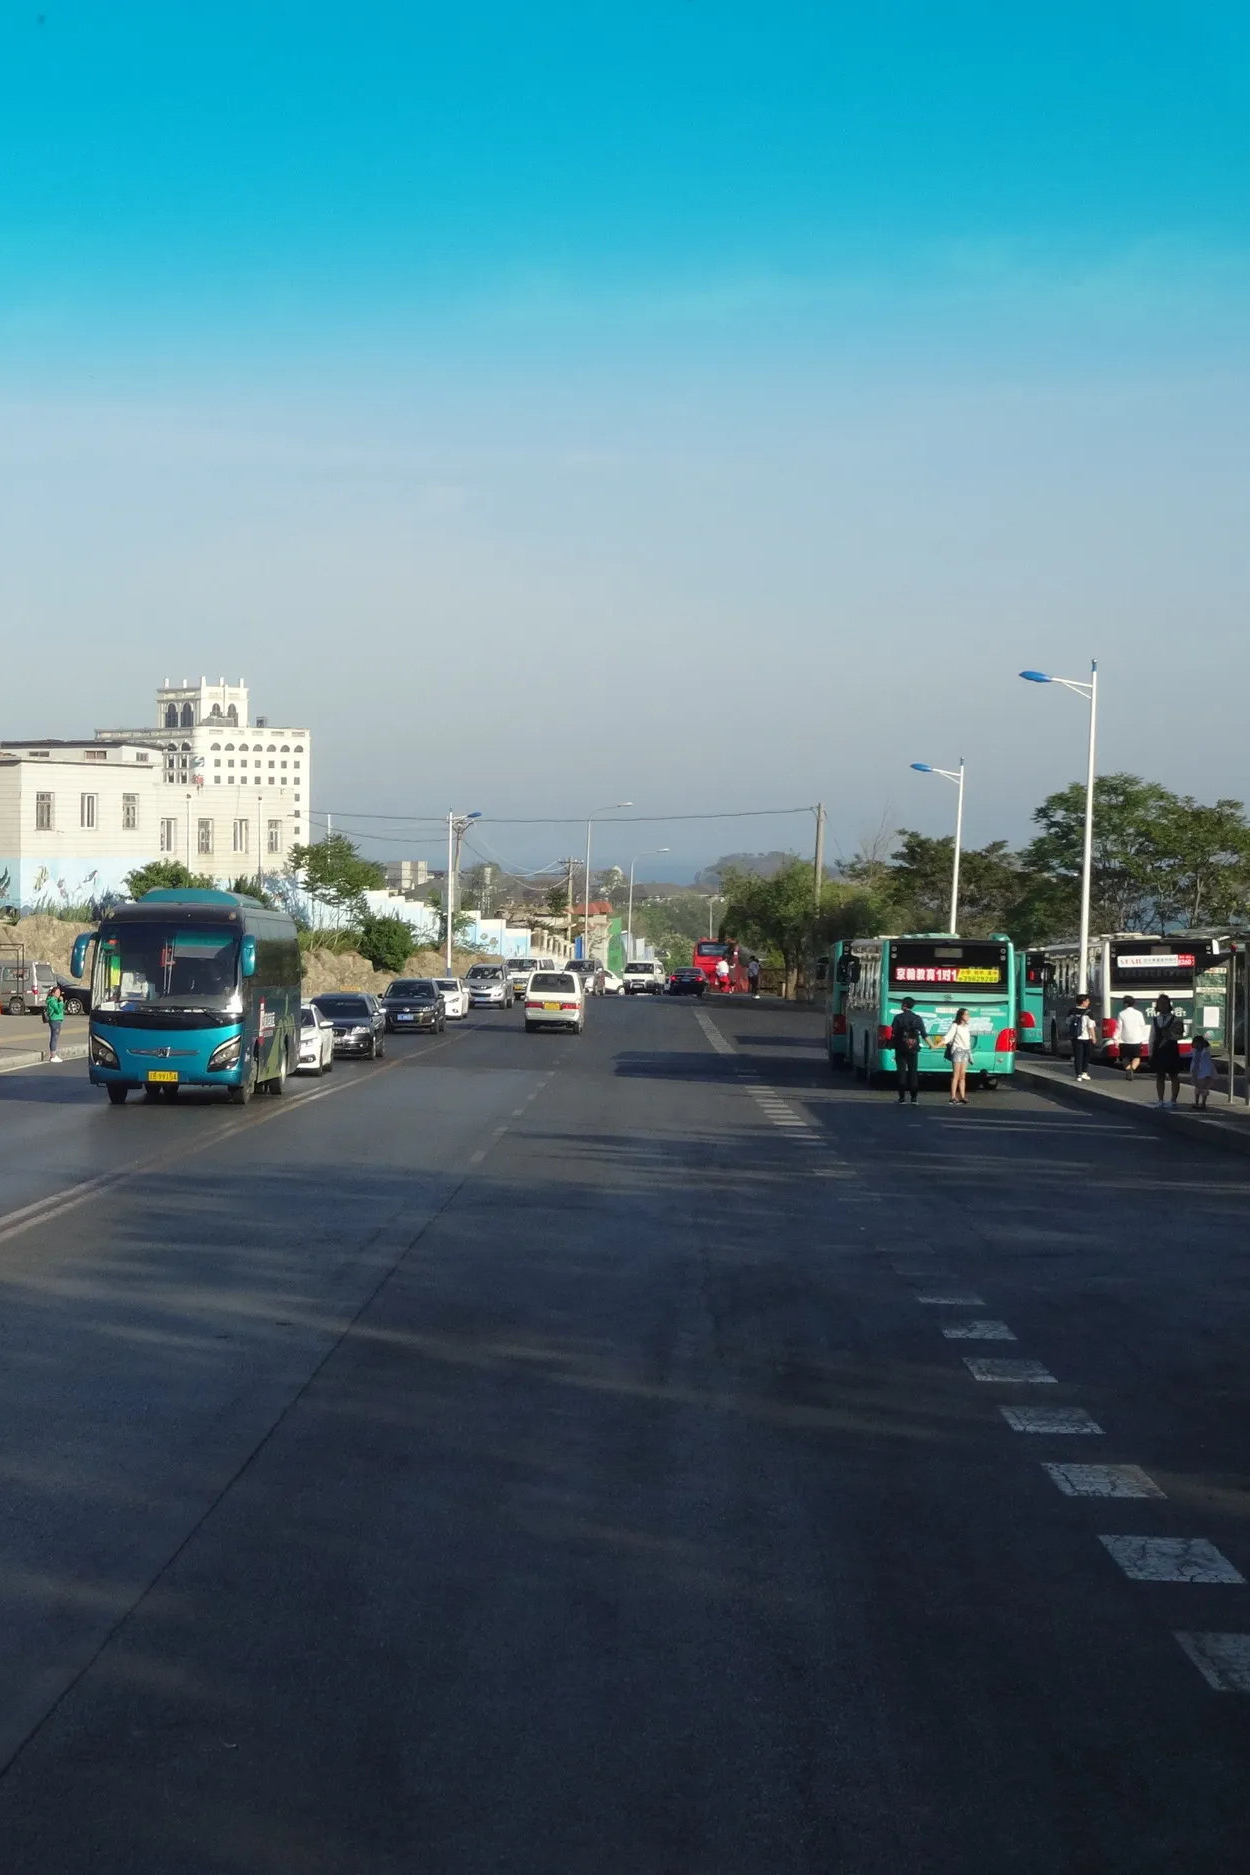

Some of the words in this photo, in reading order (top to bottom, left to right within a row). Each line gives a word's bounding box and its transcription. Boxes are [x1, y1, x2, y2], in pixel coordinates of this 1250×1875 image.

[896, 967, 957, 981] 京翰教育1对1
